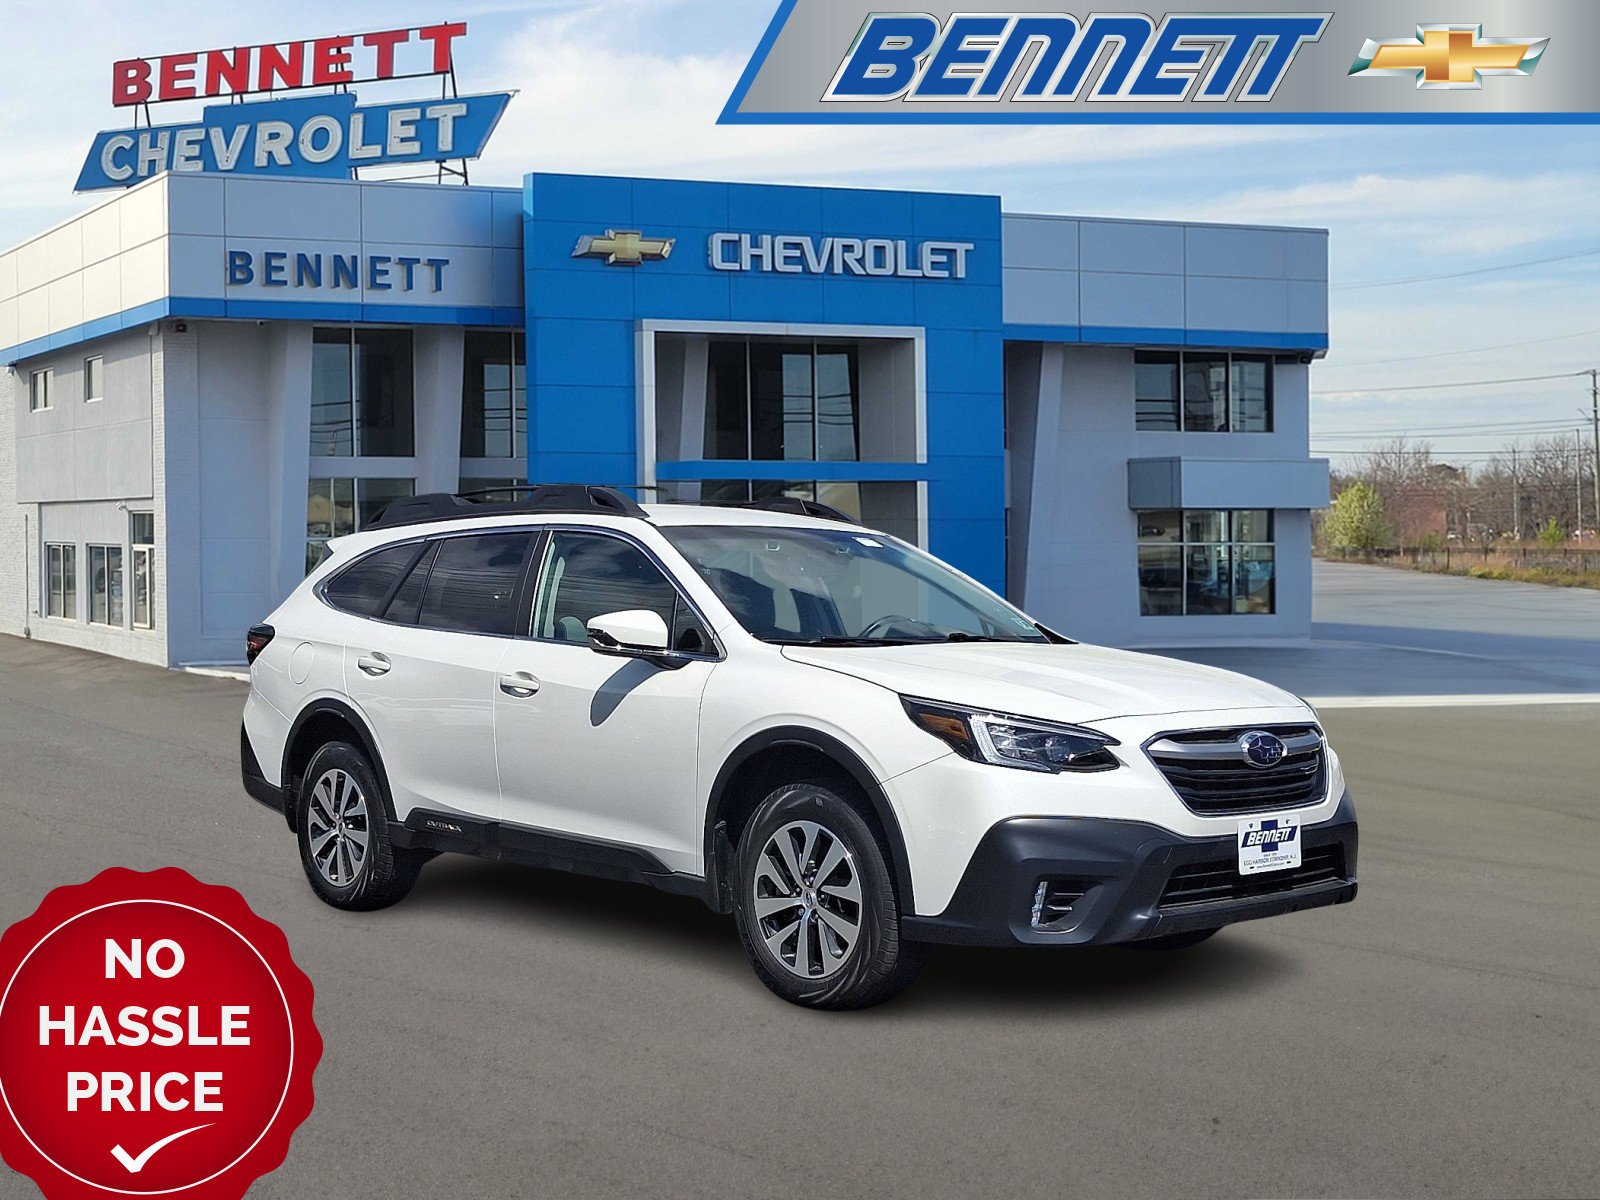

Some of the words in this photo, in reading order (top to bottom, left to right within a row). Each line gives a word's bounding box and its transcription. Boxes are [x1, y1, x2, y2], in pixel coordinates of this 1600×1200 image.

[112, 22, 467, 107] BENNETT
[99, 103, 468, 181] CHEVROLET
[226, 249, 450, 293] BENNETT
[707, 232, 975, 279] CHEVROLET
[1247, 828, 1292, 846] BENNETT
